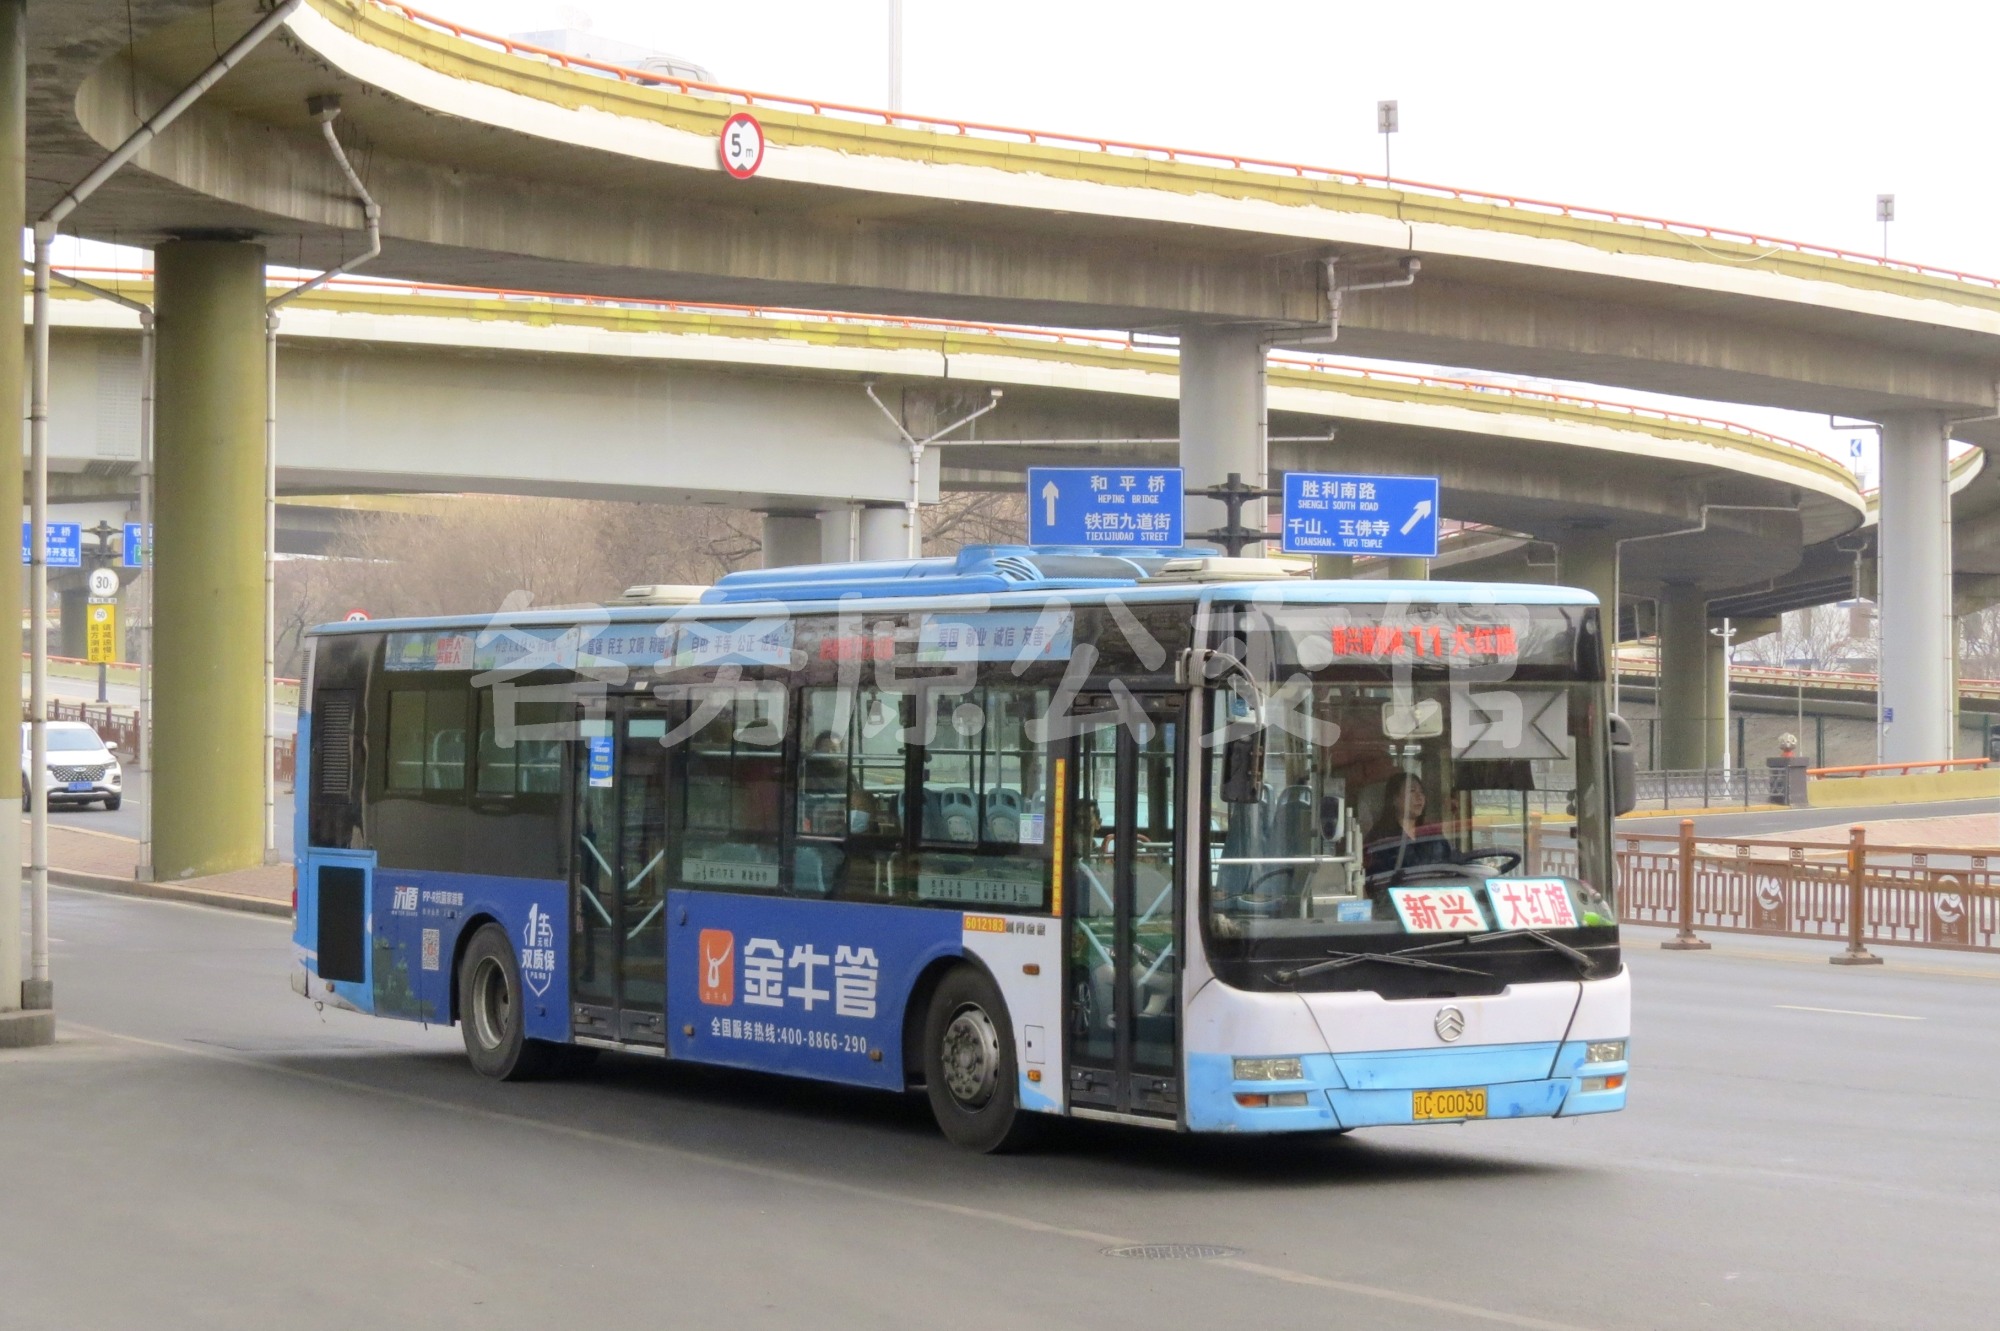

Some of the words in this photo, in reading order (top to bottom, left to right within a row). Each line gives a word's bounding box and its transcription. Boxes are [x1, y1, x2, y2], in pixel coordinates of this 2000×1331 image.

[1090, 475, 1166, 493] 和平桥
[1301, 480, 1377, 500] 胜利南路
[1097, 495, 1127, 504] HEPING
[1131, 495, 1159, 505] BRIDGE
[1297, 500, 1328, 510] SHENGLI
[1332, 501, 1352, 511] SOUTH
[1356, 502, 1379, 511] ROAD
[1084, 513, 1171, 531] 铁西九道街
[1085, 532, 1134, 541] TIEXIJIUDAO
[1140, 532, 1169, 541] STREET
[1343, 539, 1358, 548] YUFO
[1360, 539, 1383, 549] TEMPLE
[607, 638, 622, 655] 民主
[628, 636, 644, 654] 文明
[938, 629, 959, 648] 爱国
[1410, 627, 1442, 657] 11
[1451, 626, 1518, 655] 大红旗
[1402, 894, 1479, 930] 新兴
[1502, 883, 1575, 927] 大红旗
[965, 916, 1004, 932] 6012183
[521, 949, 555, 971] 双质保
[744, 937, 879, 1019] 金牛管
